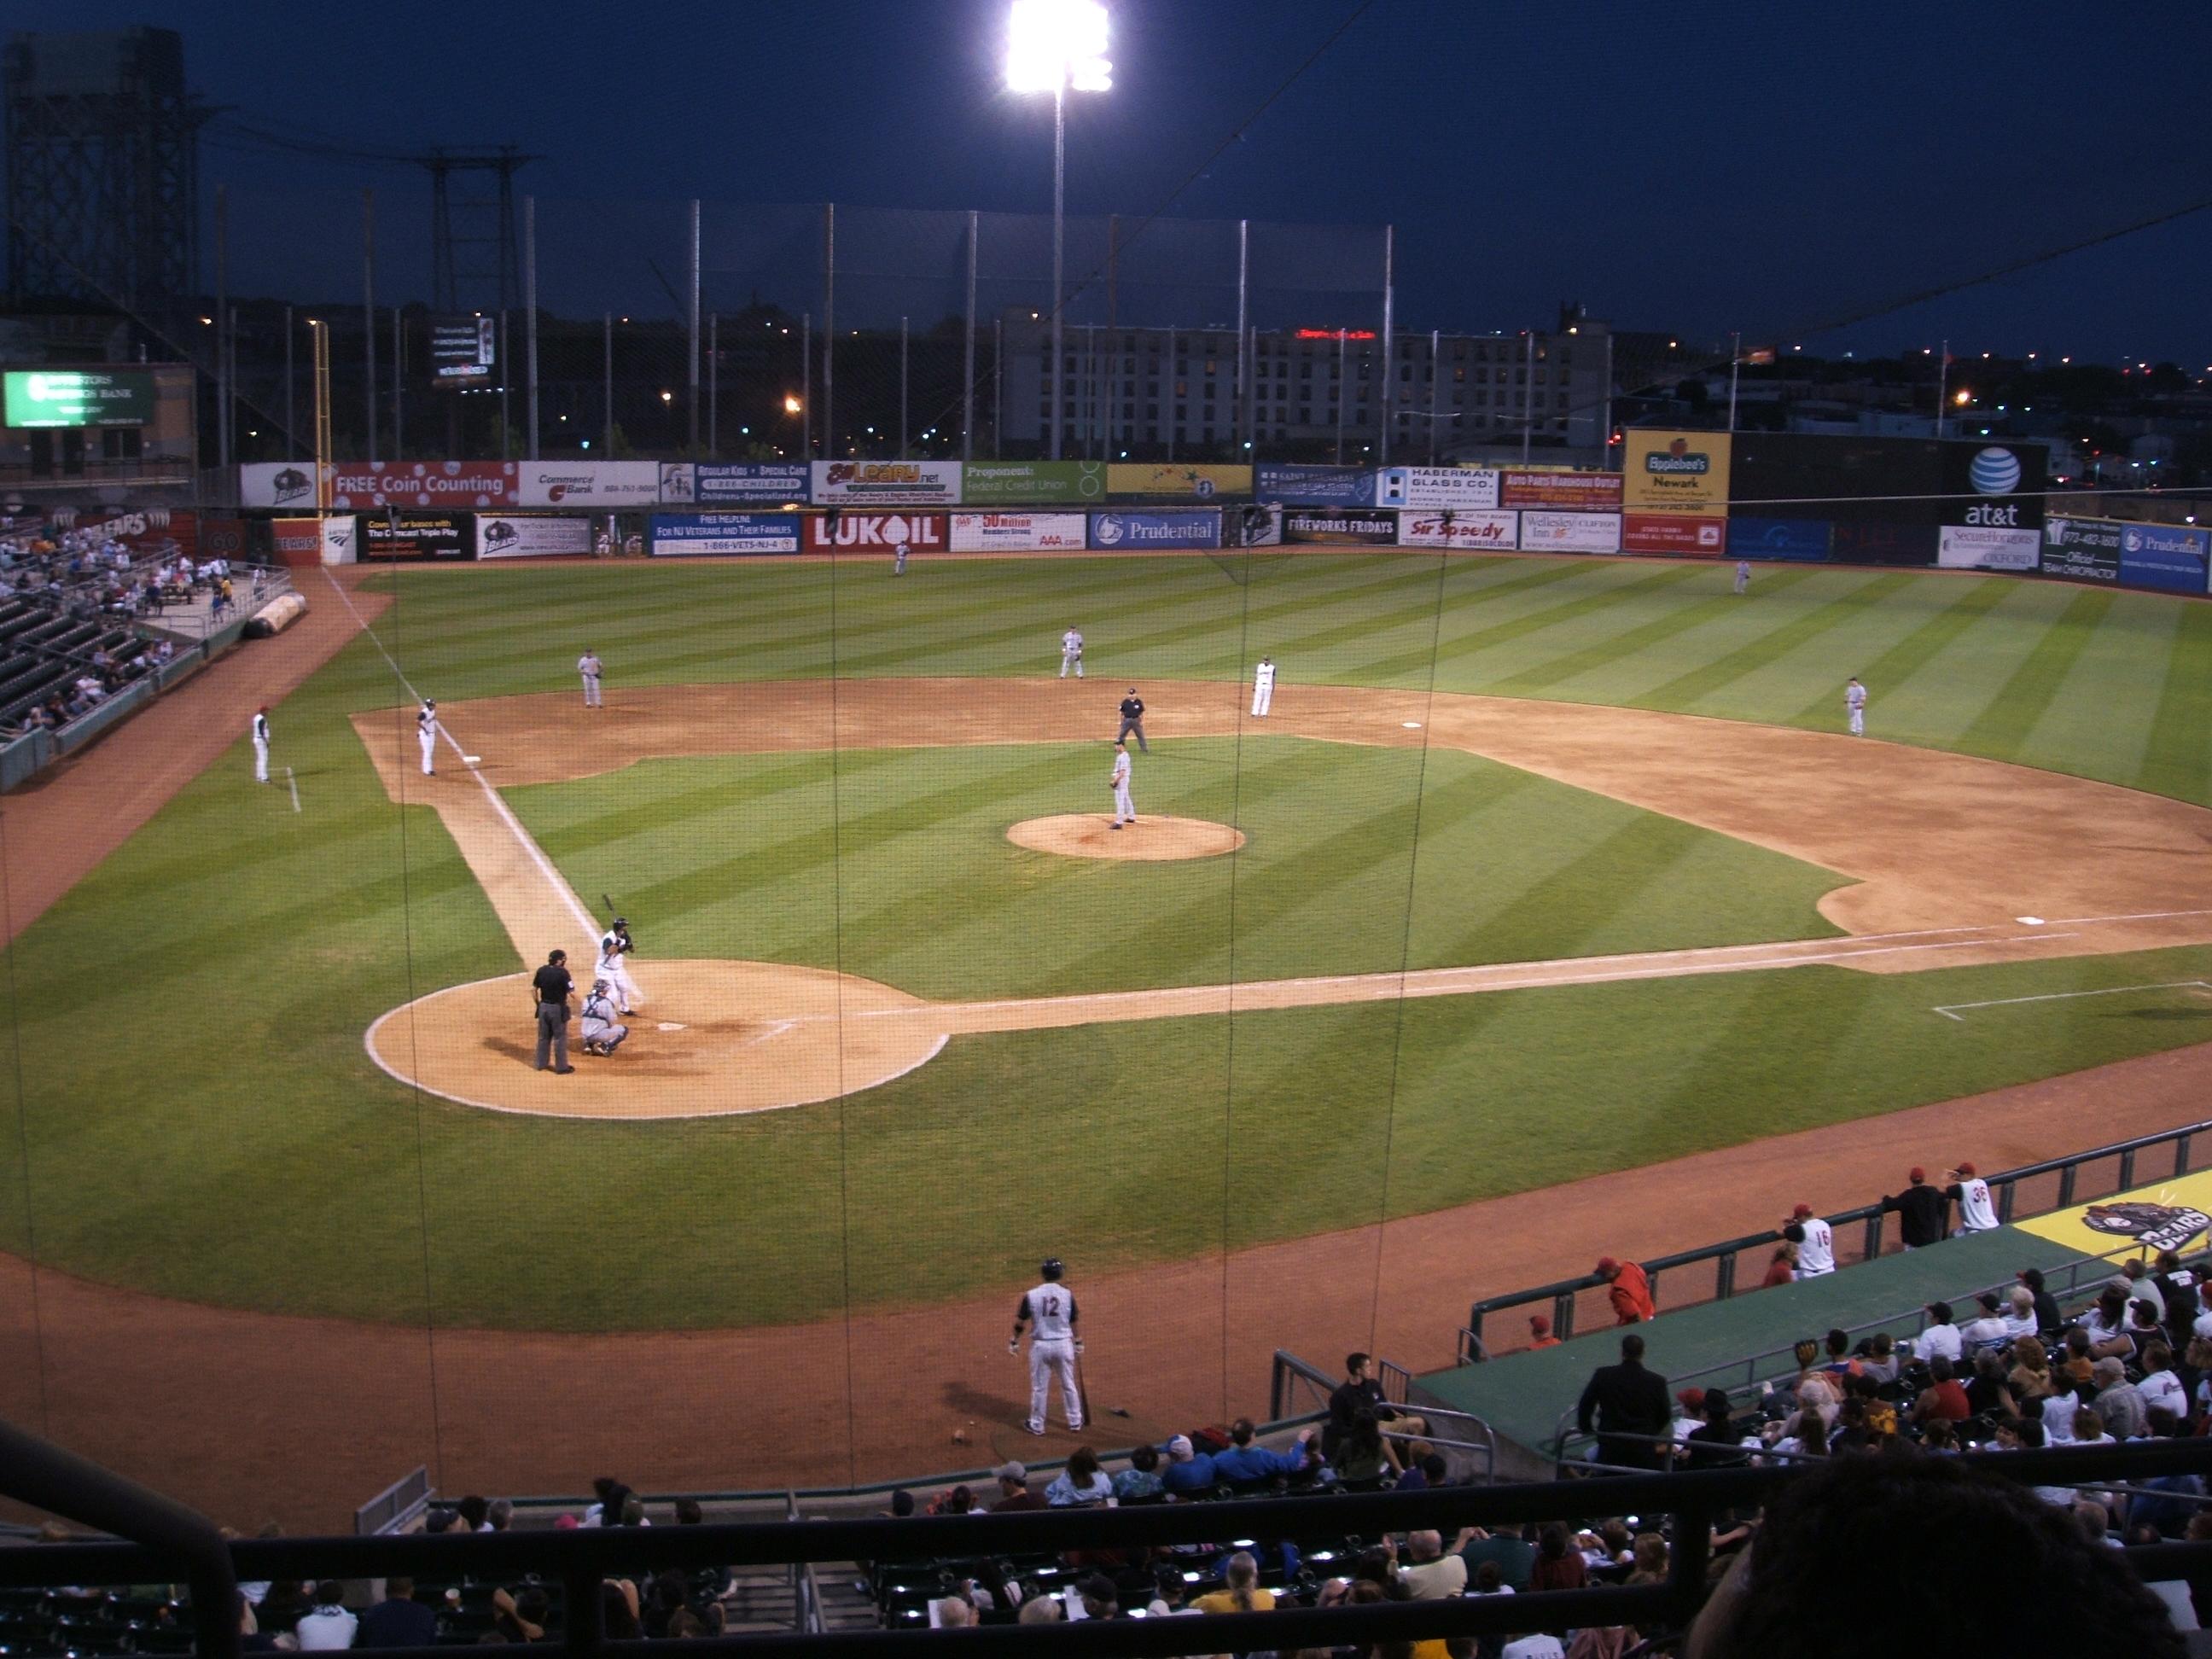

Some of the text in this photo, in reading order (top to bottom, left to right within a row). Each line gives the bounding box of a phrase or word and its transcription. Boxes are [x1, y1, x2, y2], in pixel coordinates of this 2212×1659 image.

[539, 474, 595, 484] Commerce
[1412, 469, 1493, 480] HABERMAN
[337, 474, 504, 495] FREE Coin Counting
[1413, 479, 1493, 488] GLASS CO.
[1654, 476, 1699, 487] Newark
[567, 485, 593, 493] Bank
[1965, 503, 2018, 526] at&t
[1288, 519, 1394, 533] FIREWORKS FRIDAYS
[1528, 515, 1575, 527] Wellesley
[385, 529, 419, 538] Cmcast
[1129, 521, 1213, 539] Prudential
[1437, 521, 1505, 539] Speedy
[1534, 527, 1551, 538] Inn
[2139, 1208, 2210, 1251] BEARS
[1042, 1295, 1061, 1317] 12
